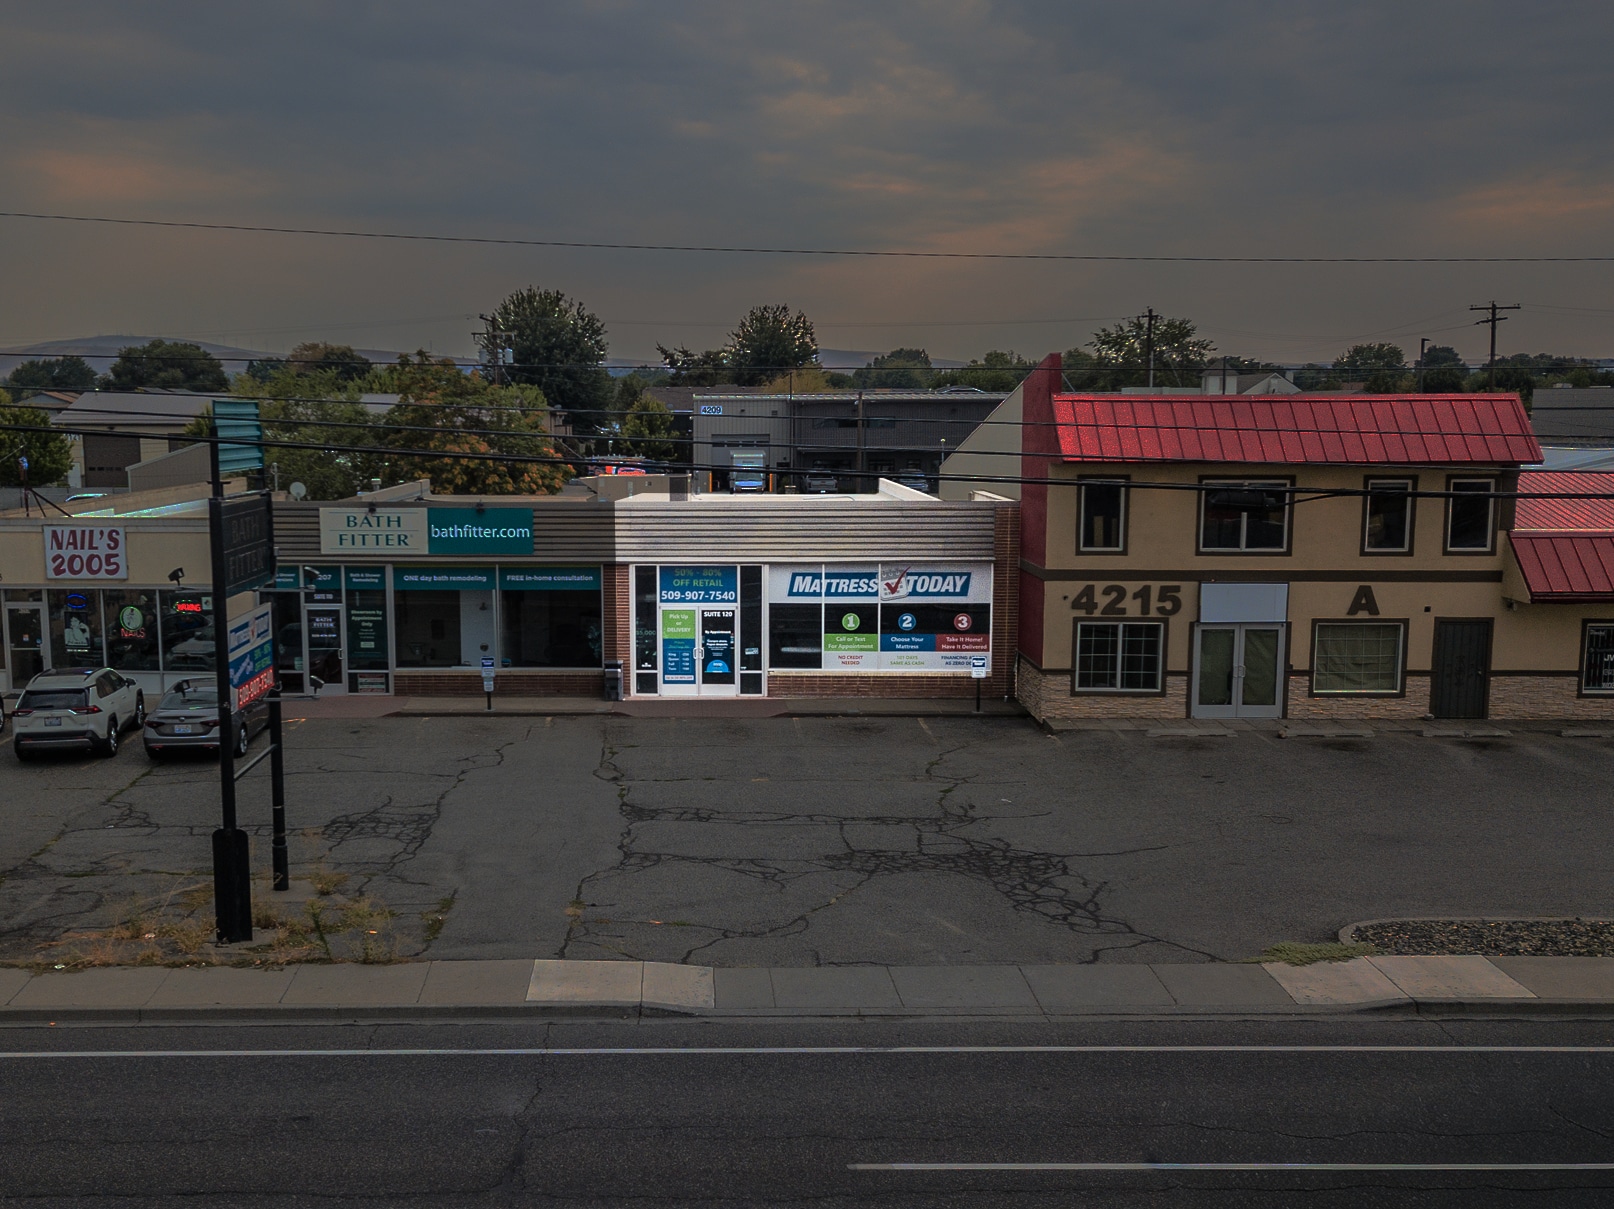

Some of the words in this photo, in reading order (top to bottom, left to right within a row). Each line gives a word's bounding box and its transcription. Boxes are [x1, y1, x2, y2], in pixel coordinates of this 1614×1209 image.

[702, 406, 722, 414] 4209
[346, 515, 401, 528] BATH
[430, 524, 530, 538] bathfitter.com
[50, 529, 120, 551] NAIL'S
[339, 533, 409, 546] FITTER
[51, 553, 120, 577] 2005
[674, 568, 694, 577] 50%
[702, 568, 722, 577] 80%
[449, 575, 487, 583] remodeling
[673, 578, 690, 587] OFF
[692, 578, 723, 587] RETAIL
[792, 575, 878, 593] MATTRESS
[906, 575, 968, 592] TODAY
[661, 590, 735, 601] 509-907-7540
[1071, 584, 1182, 616] 4215
[1347, 585, 1380, 616] A
[846, 616, 855, 628] 1
[902, 616, 912, 628] 2
[957, 616, 968, 628] 3
